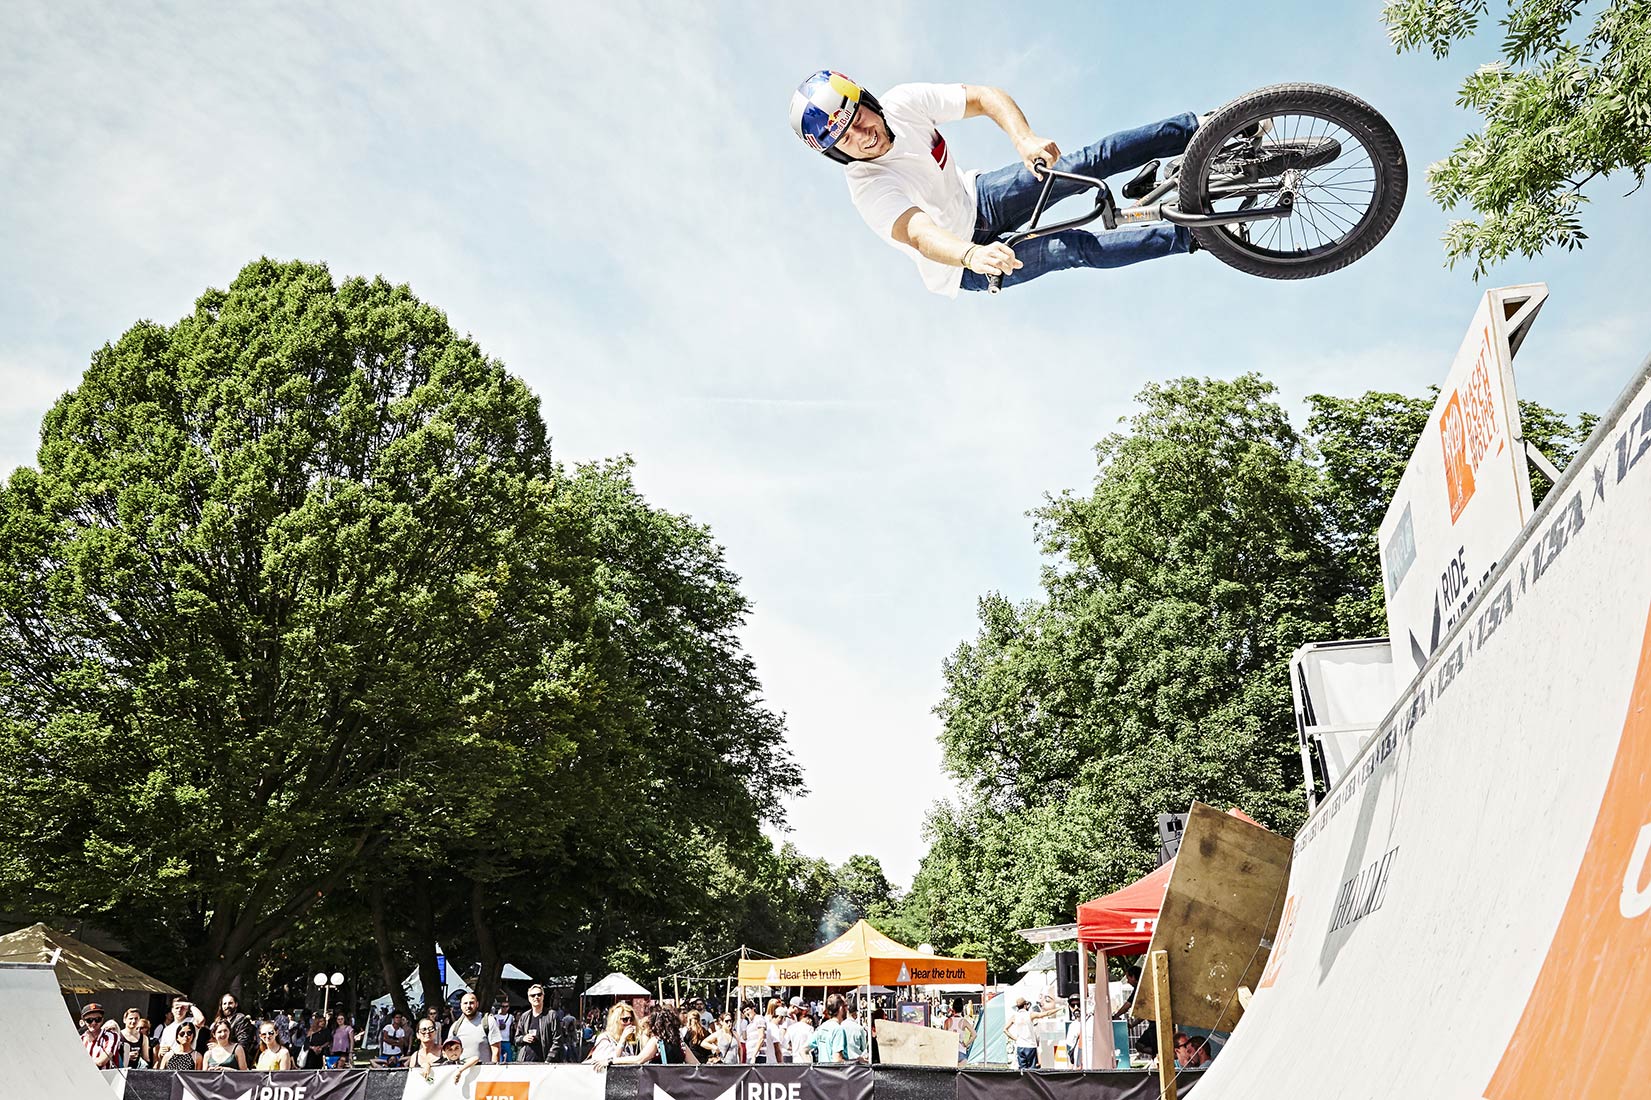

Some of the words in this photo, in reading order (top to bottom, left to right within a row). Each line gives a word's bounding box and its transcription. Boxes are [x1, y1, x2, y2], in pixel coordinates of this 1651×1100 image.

[840, 109, 852, 126] Bull
[1462, 347, 1488, 414] MACHT
[1466, 367, 1491, 437] DOCH
[1441, 545, 1469, 611] RIDE
[779, 968, 800, 980] Hear
[802, 968, 818, 980] the
[818, 968, 842, 980] truth
[910, 967, 931, 979] Hear
[931, 967, 945, 979] the
[945, 967, 966, 979] truth
[748, 1082, 801, 1100] RIDE
